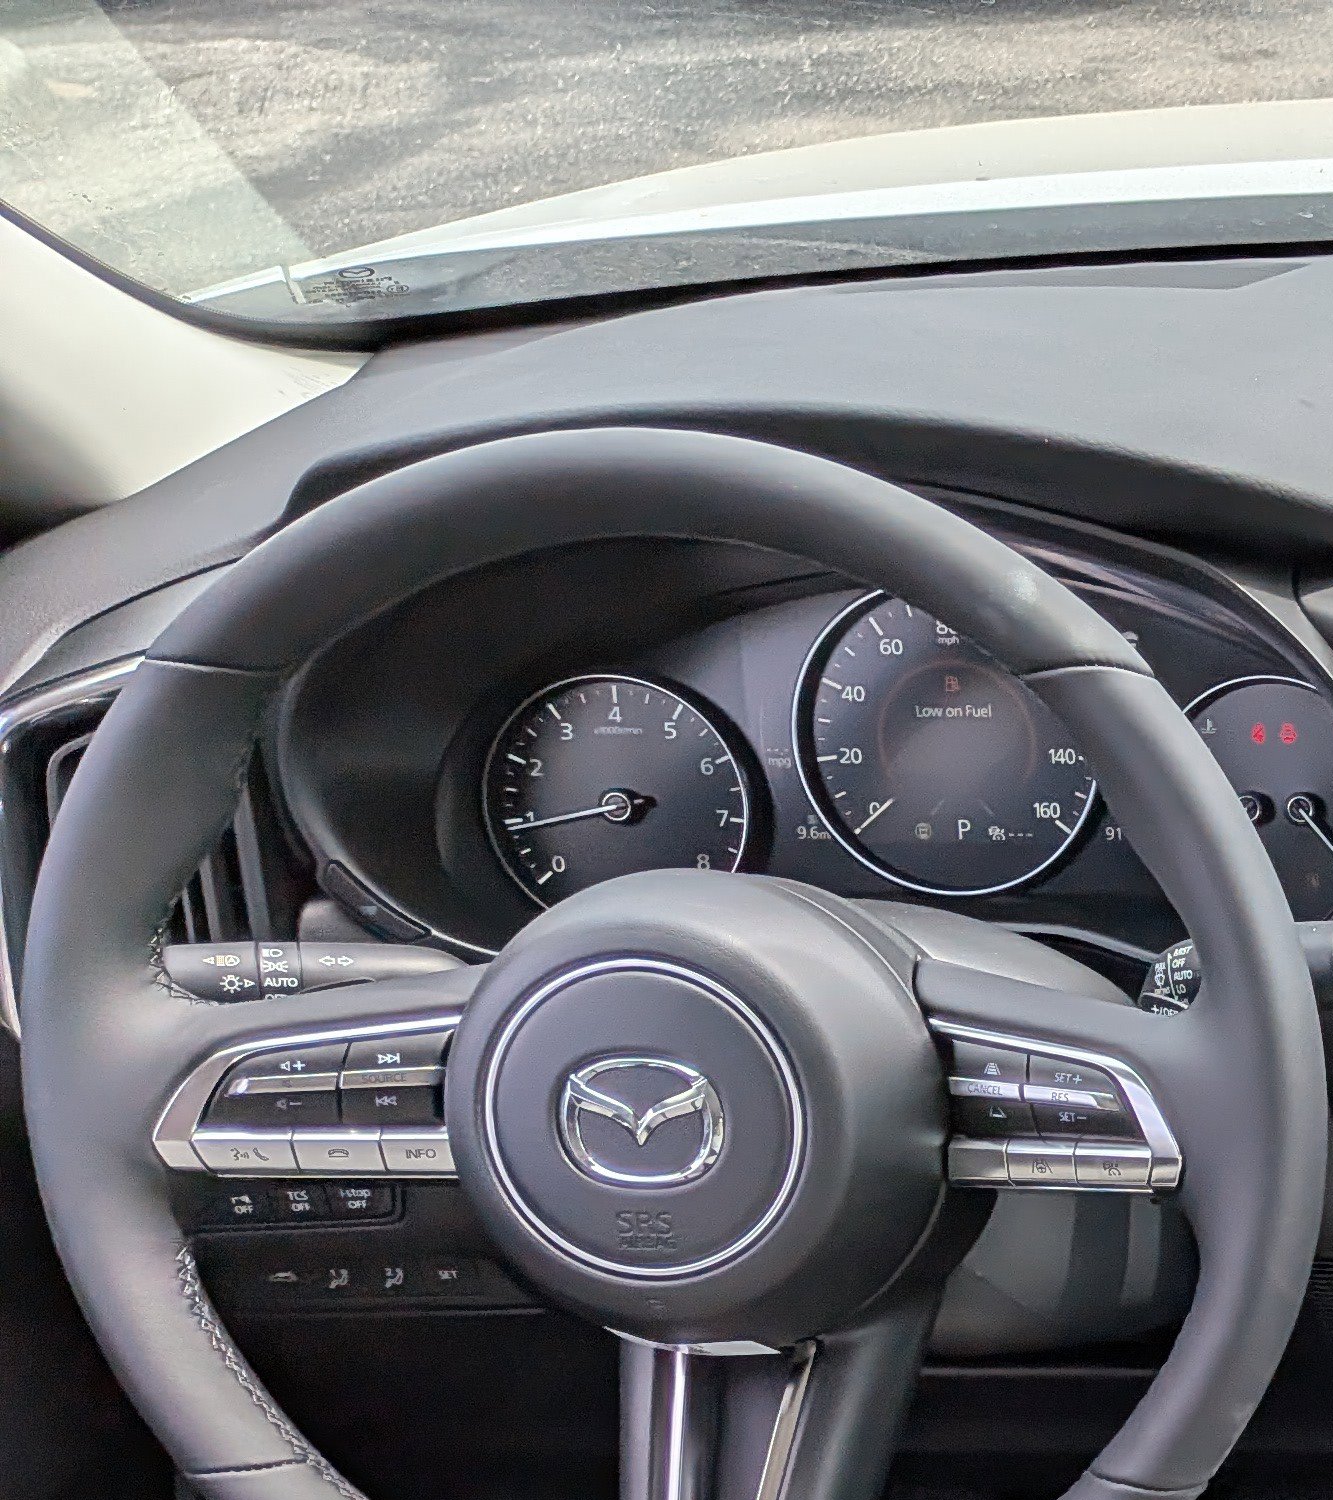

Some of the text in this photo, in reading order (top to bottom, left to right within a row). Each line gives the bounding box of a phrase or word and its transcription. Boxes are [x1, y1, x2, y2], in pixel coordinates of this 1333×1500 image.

[880, 639, 903, 655] 60
[841, 686, 865, 702] 40
[608, 707, 622, 723] 4
[915, 703, 992, 718] Low on Fuel
[560, 723, 573, 740] 3
[664, 722, 677, 740] 5
[839, 748, 862, 764] 20
[1049, 748, 1076, 765] 140
[530, 758, 543, 777] 2
[700, 758, 714, 775] 6
[525, 811, 535, 822] 1
[1033, 802, 1060, 819] 160
[715, 810, 729, 828] 7
[957, 819, 971, 840] P
[552, 855, 566, 873] 0
[696, 853, 711, 871] 8
[1172, 958, 1186, 969] OFF
[263, 977, 299, 988] AUTO
[1173, 970, 1193, 981] AUTO
[361, 1072, 407, 1084] SOURCE
[967, 1083, 1003, 1096] CANCEL
[1051, 1091, 1069, 1102] RES
[405, 1148, 437, 1159] INFO
[286, 1190, 309, 1201] TCS
[234, 1205, 253, 1215] OFF
[348, 1200, 367, 1209] OFF
[616, 1210, 673, 1238] SRS
